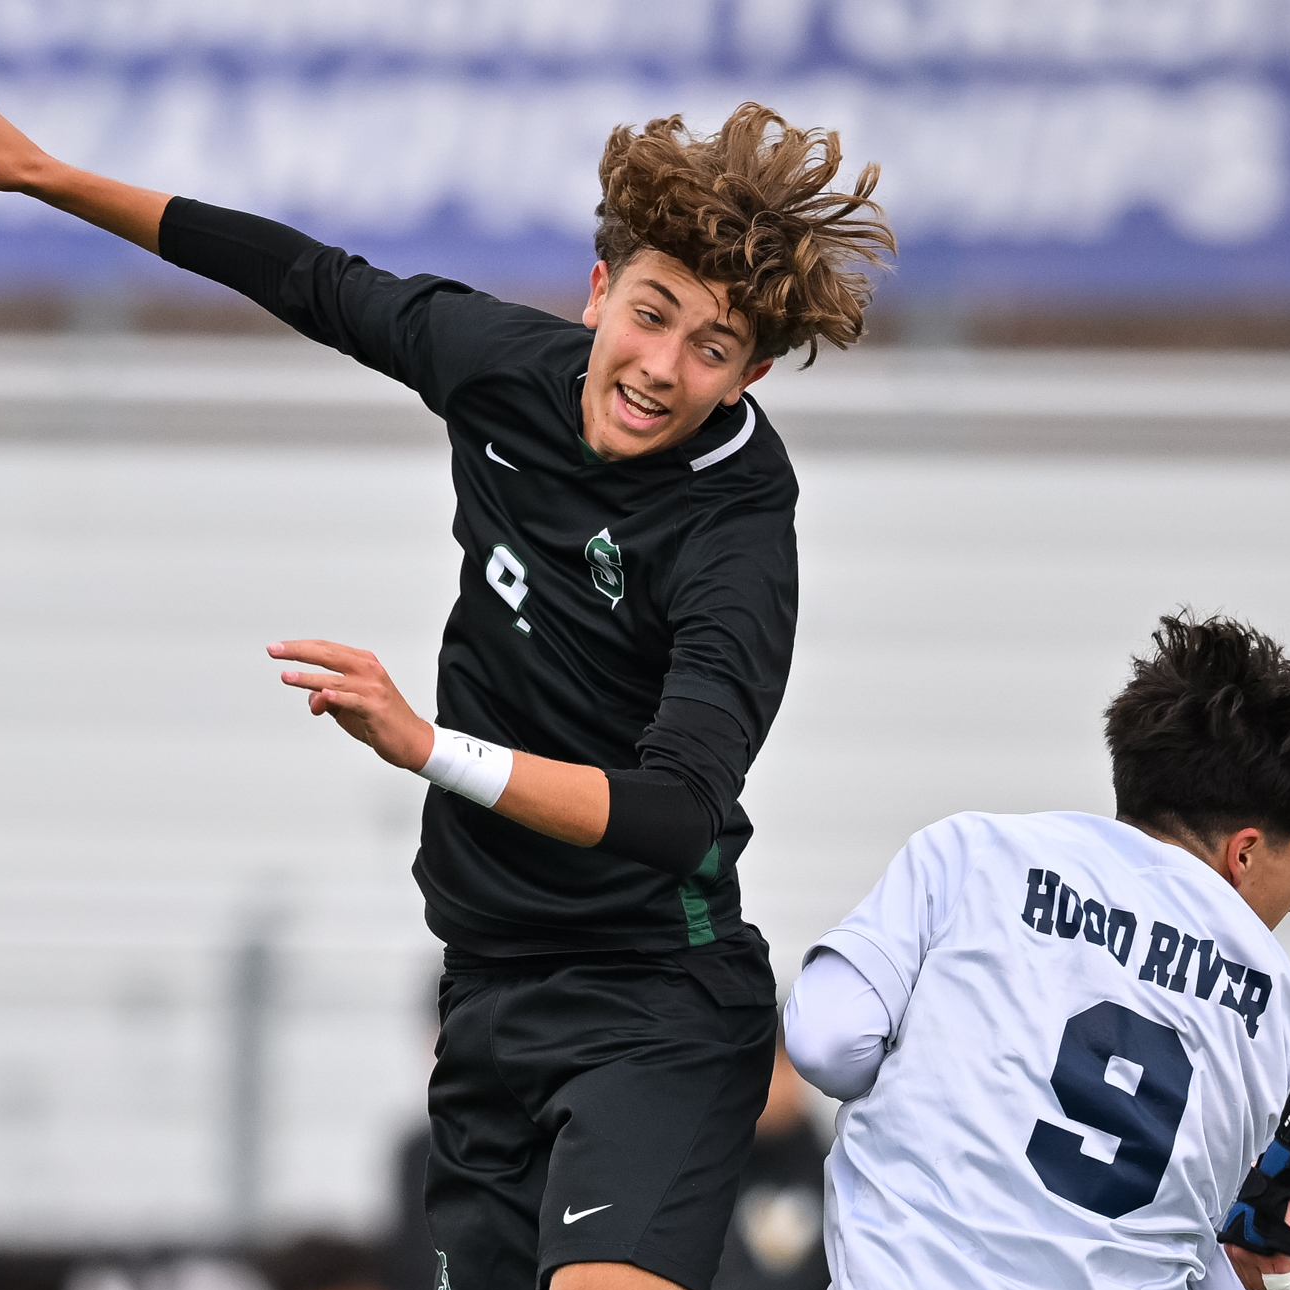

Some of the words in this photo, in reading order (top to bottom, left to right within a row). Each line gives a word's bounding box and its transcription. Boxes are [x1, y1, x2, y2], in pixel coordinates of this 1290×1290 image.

[1021, 868, 1137, 967] HOOD
[1138, 920, 1273, 1039] RIVER
[1026, 1000, 1194, 1220] 9
